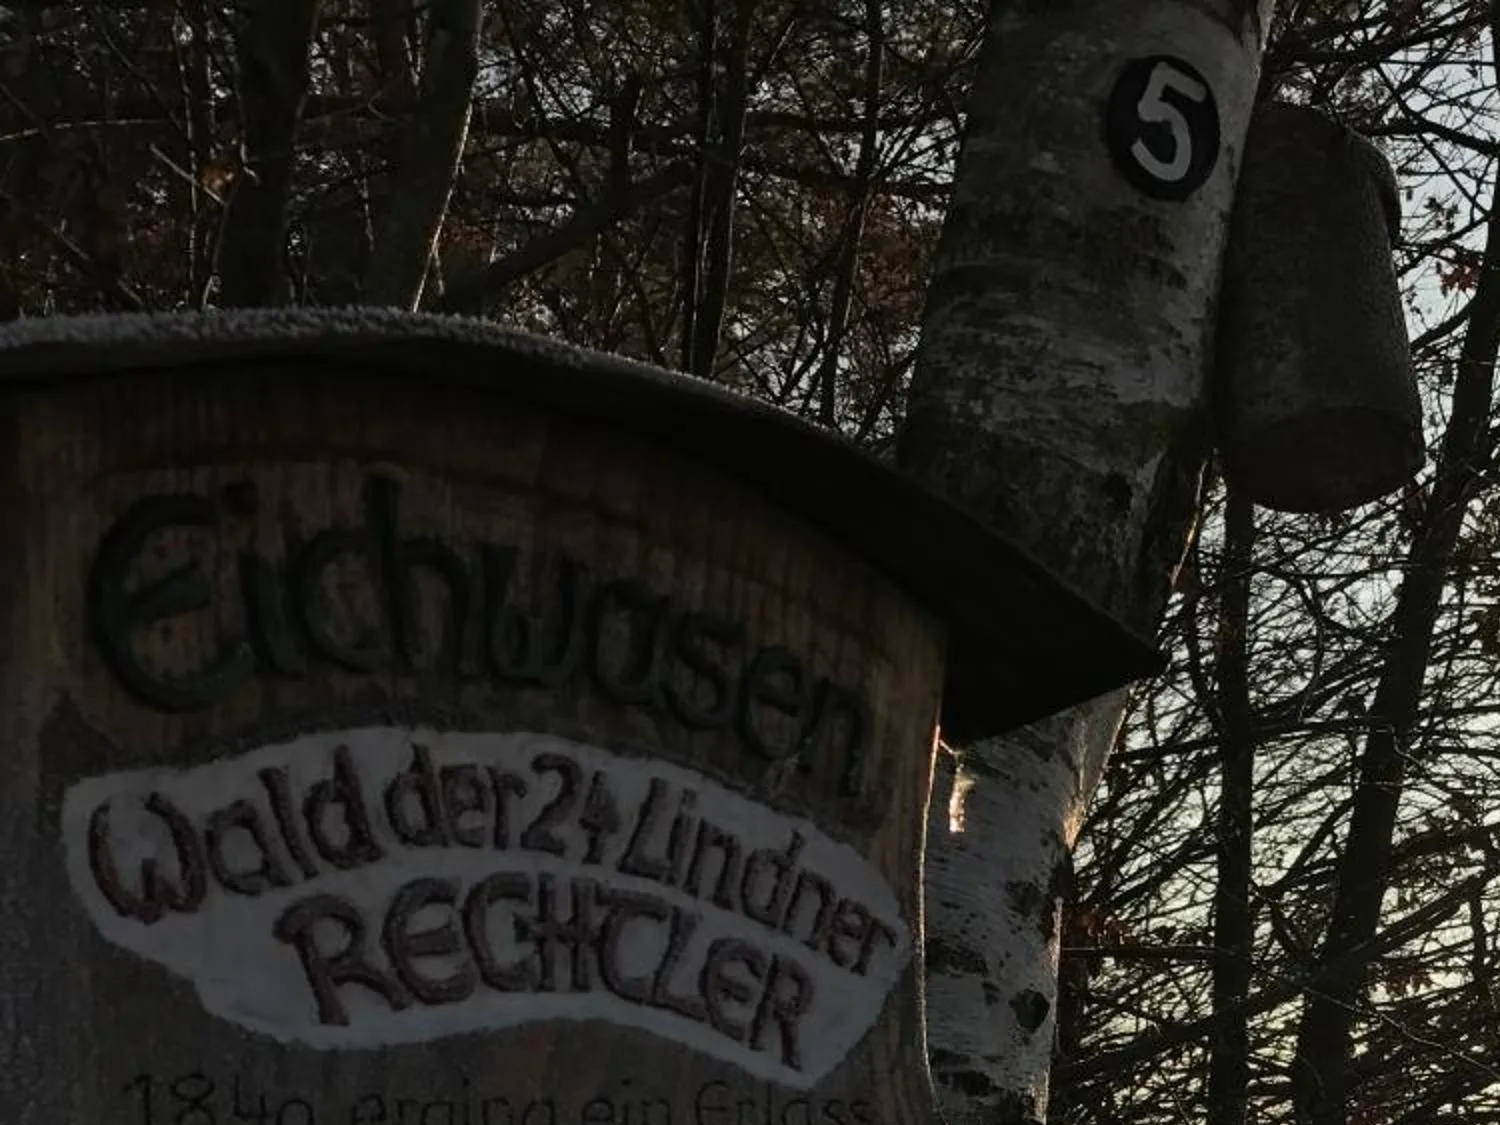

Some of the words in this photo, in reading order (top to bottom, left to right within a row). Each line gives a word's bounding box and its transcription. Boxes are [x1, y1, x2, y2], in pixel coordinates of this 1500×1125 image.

[1129, 60, 1207, 183] 5
[86, 474, 874, 803] Eichwasen
[89, 745, 382, 923] Wald
[385, 742, 528, 850] der
[620, 775, 898, 976] Lindner
